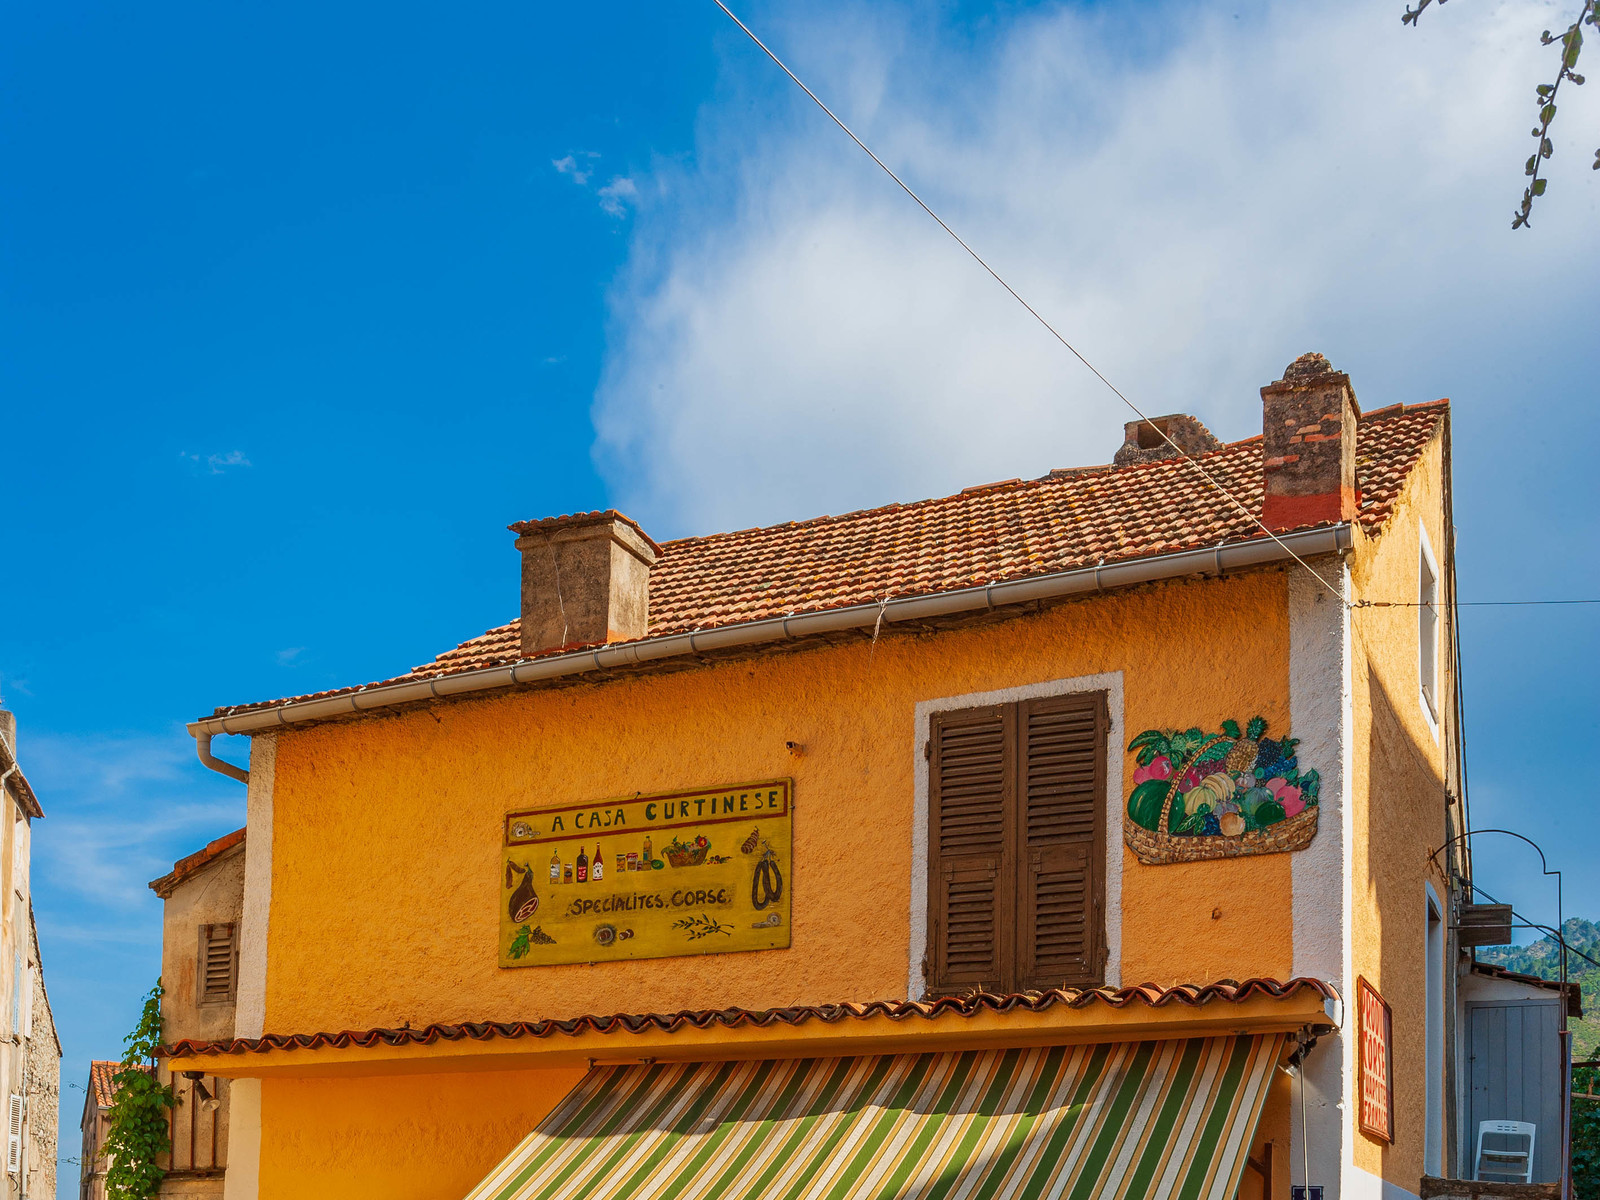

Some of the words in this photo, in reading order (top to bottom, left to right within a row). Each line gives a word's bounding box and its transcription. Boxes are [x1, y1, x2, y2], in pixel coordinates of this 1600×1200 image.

[551, 816, 565, 832] A
[575, 808, 626, 828] CASA
[646, 790, 778, 820] CURTINESE
